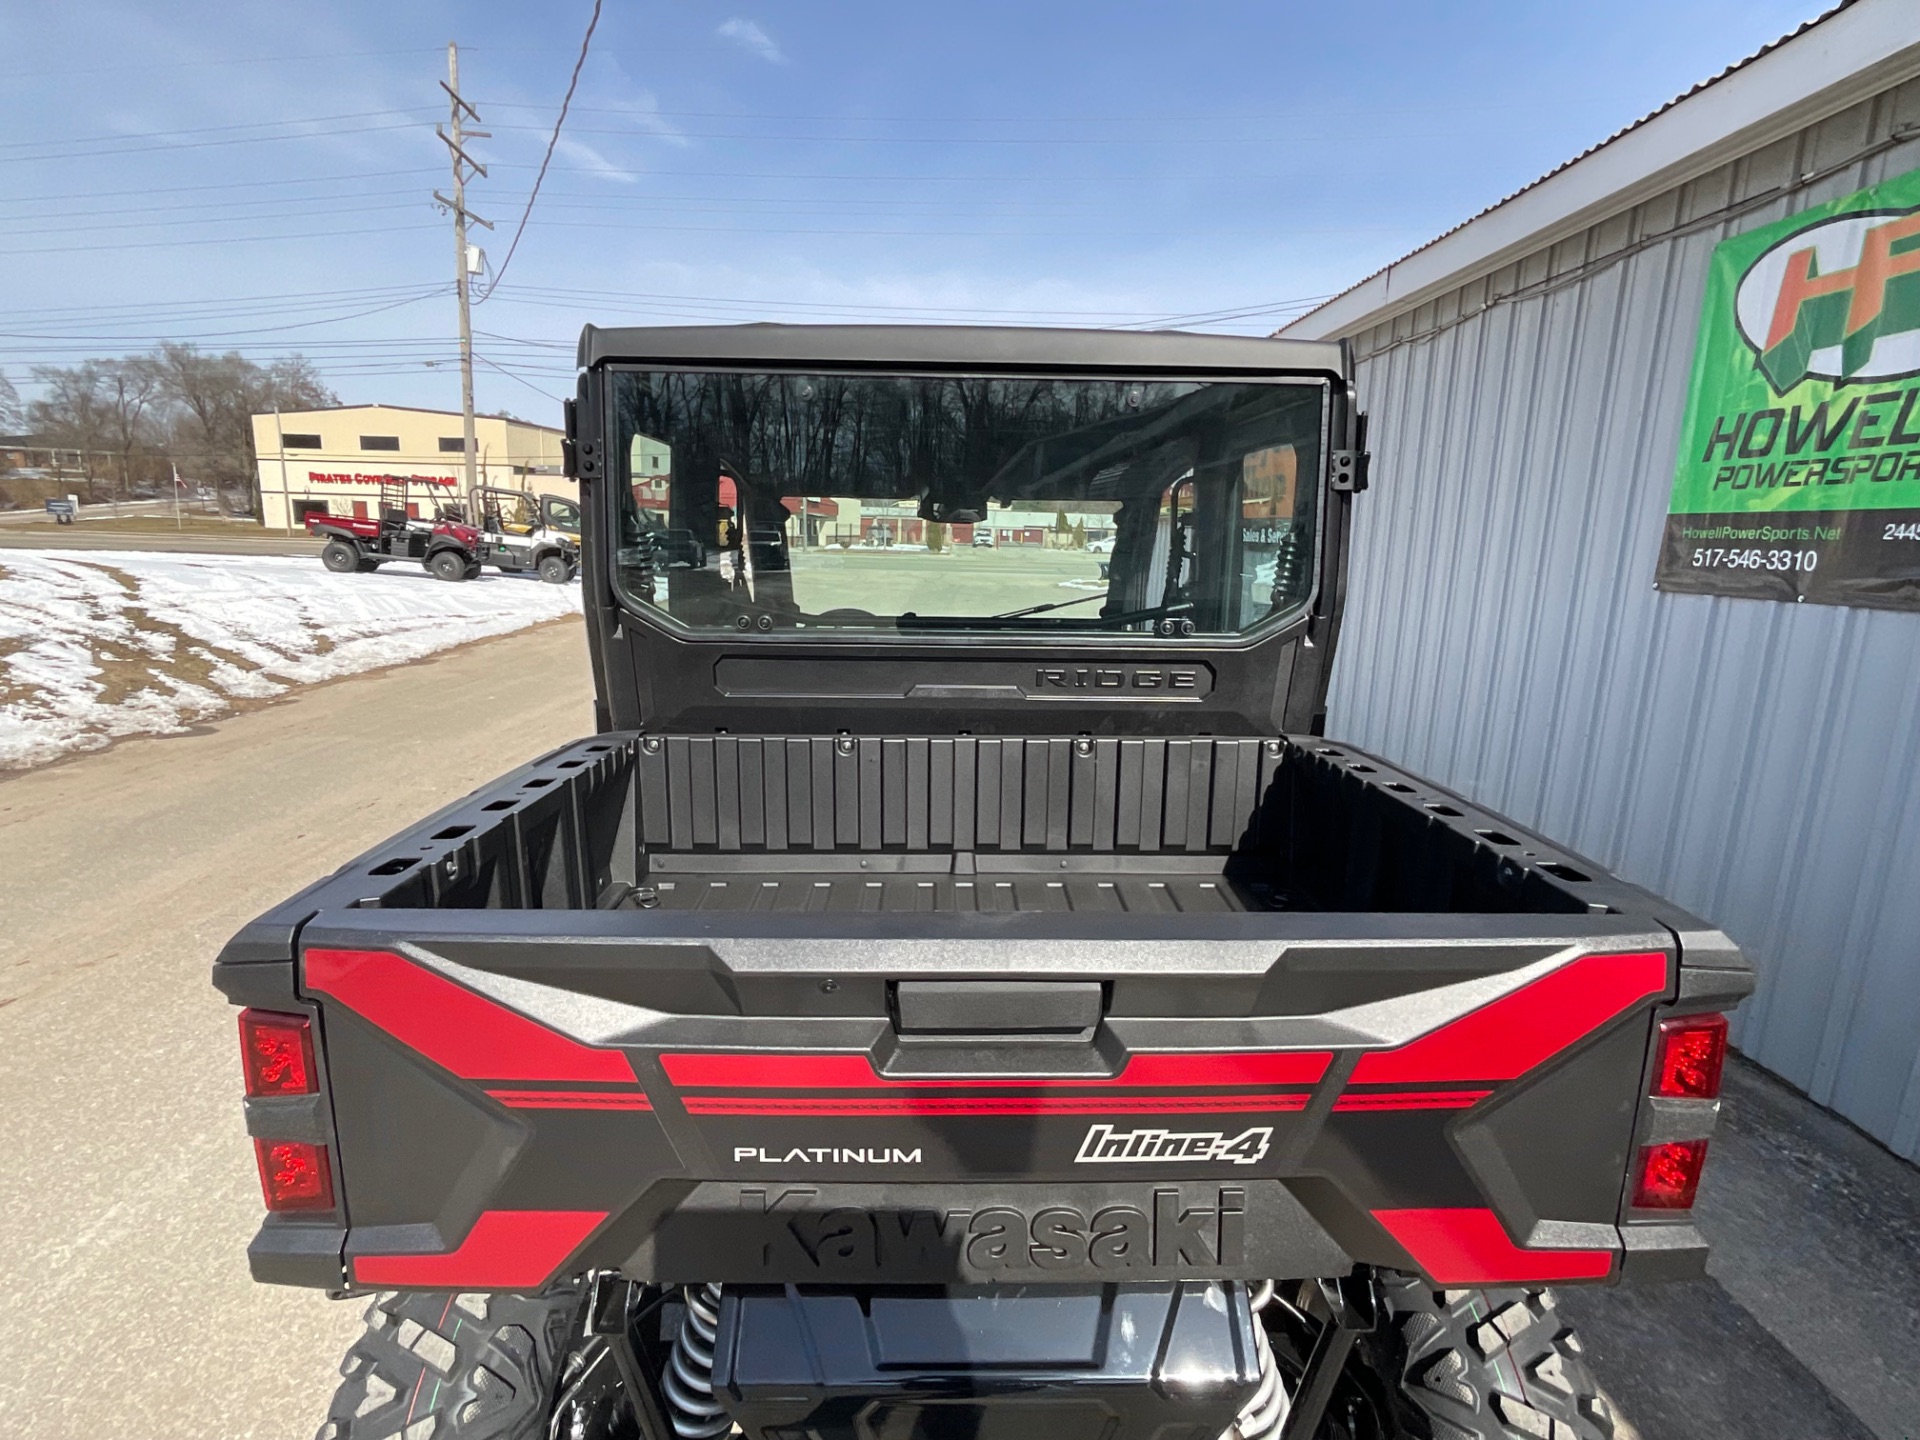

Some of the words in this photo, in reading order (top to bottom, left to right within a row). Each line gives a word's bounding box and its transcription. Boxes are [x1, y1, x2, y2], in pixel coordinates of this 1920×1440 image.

[309, 472, 352, 485] PIRATES
[1692, 548, 1818, 573] 517-546-3310
[1035, 668, 1196, 689] RIDGE
[733, 1146, 922, 1164] PLATINUM
[1074, 1123, 1274, 1165] Inline-4
[739, 1186, 1246, 1270] Kawasaki
